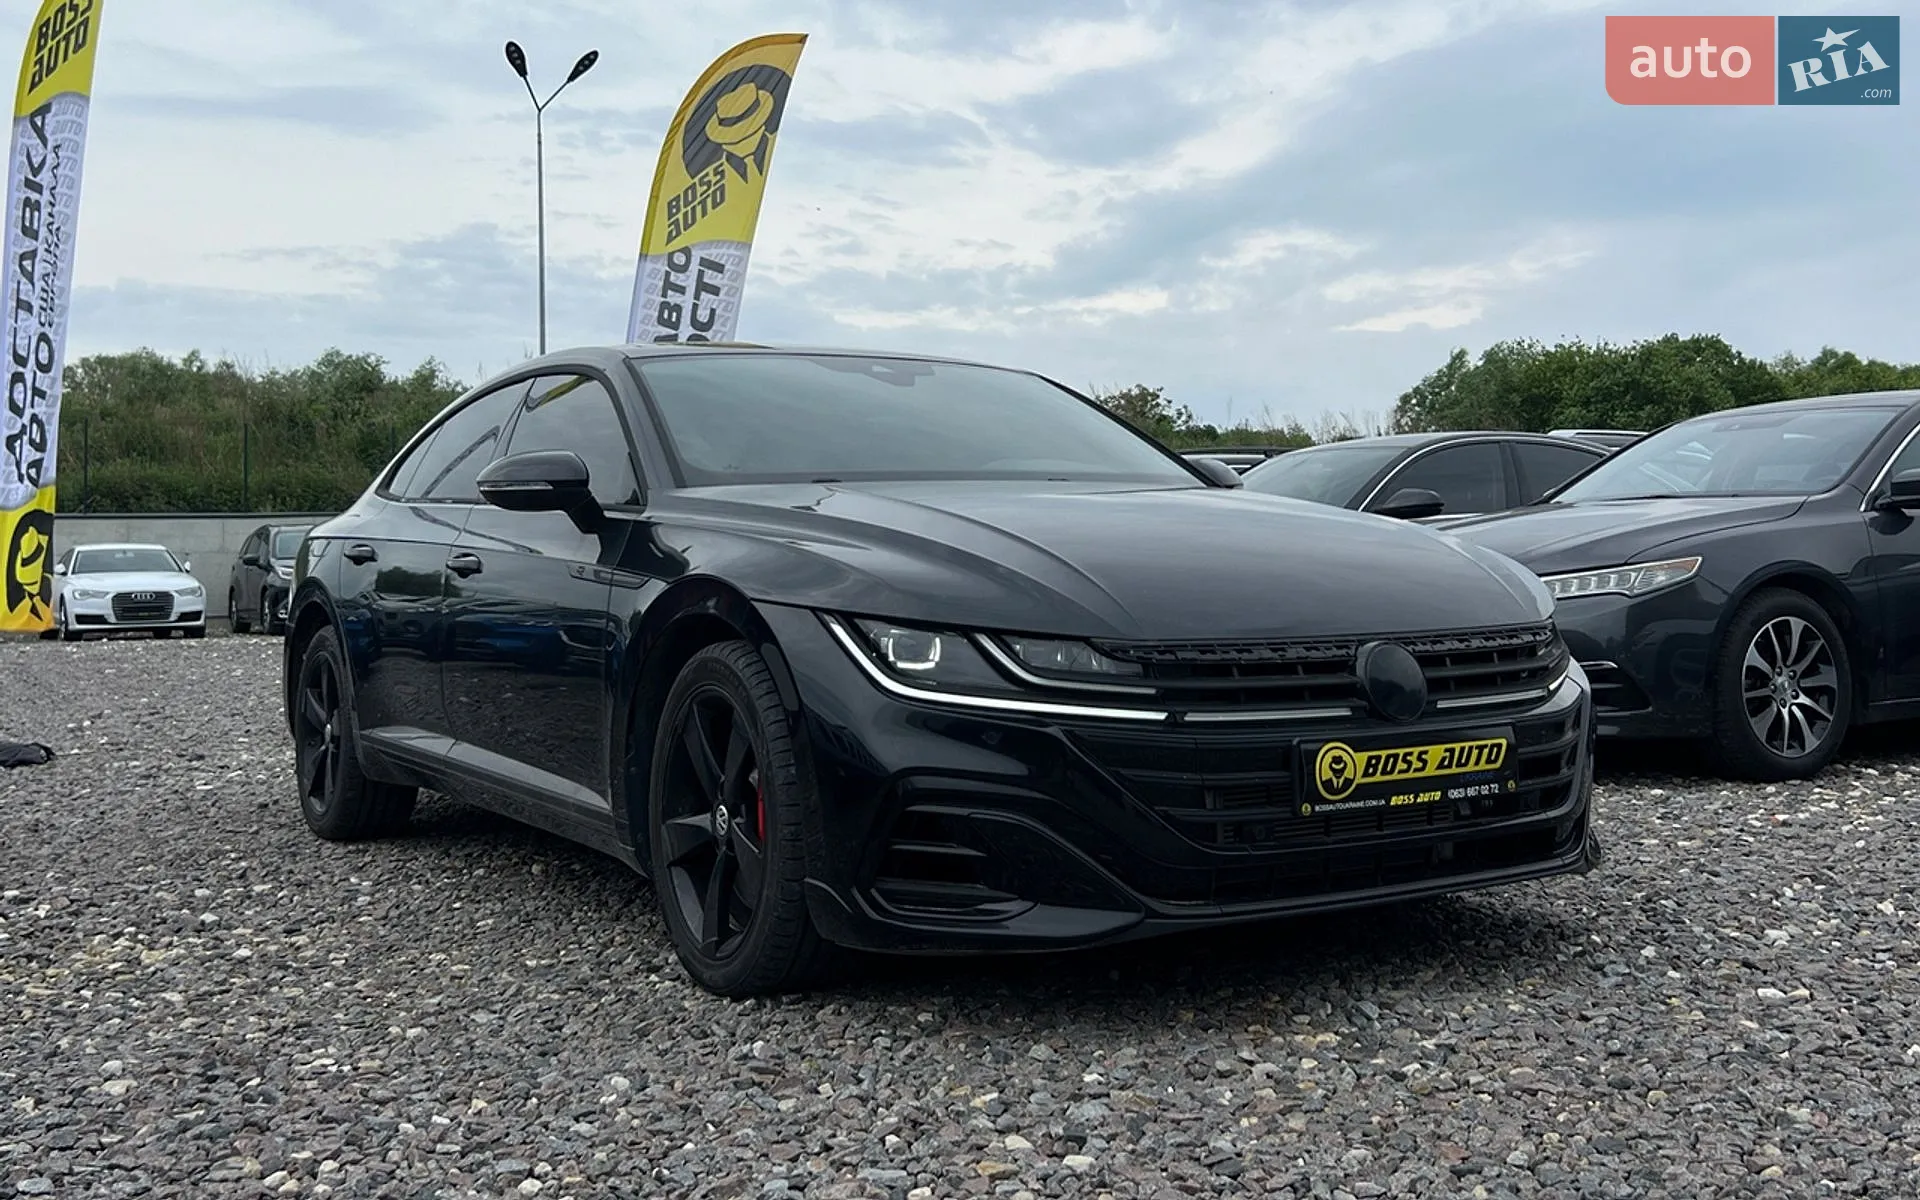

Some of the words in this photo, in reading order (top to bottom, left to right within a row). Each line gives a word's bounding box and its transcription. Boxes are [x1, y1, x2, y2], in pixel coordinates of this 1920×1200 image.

[28, 15, 89, 96] AUTO
[665, 183, 725, 246] AUTO
[668, 162, 725, 221] BOSS
[6, 102, 52, 485] ДОСТАВКА
[26, 331, 55, 489] АВТО
[1361, 750, 1430, 778] BOSS
[1435, 742, 1504, 771] AUTO
[1490, 783, 1500, 794] 72
[1390, 793, 1415, 806] BOSS
[1416, 791, 1441, 803] AUTO
